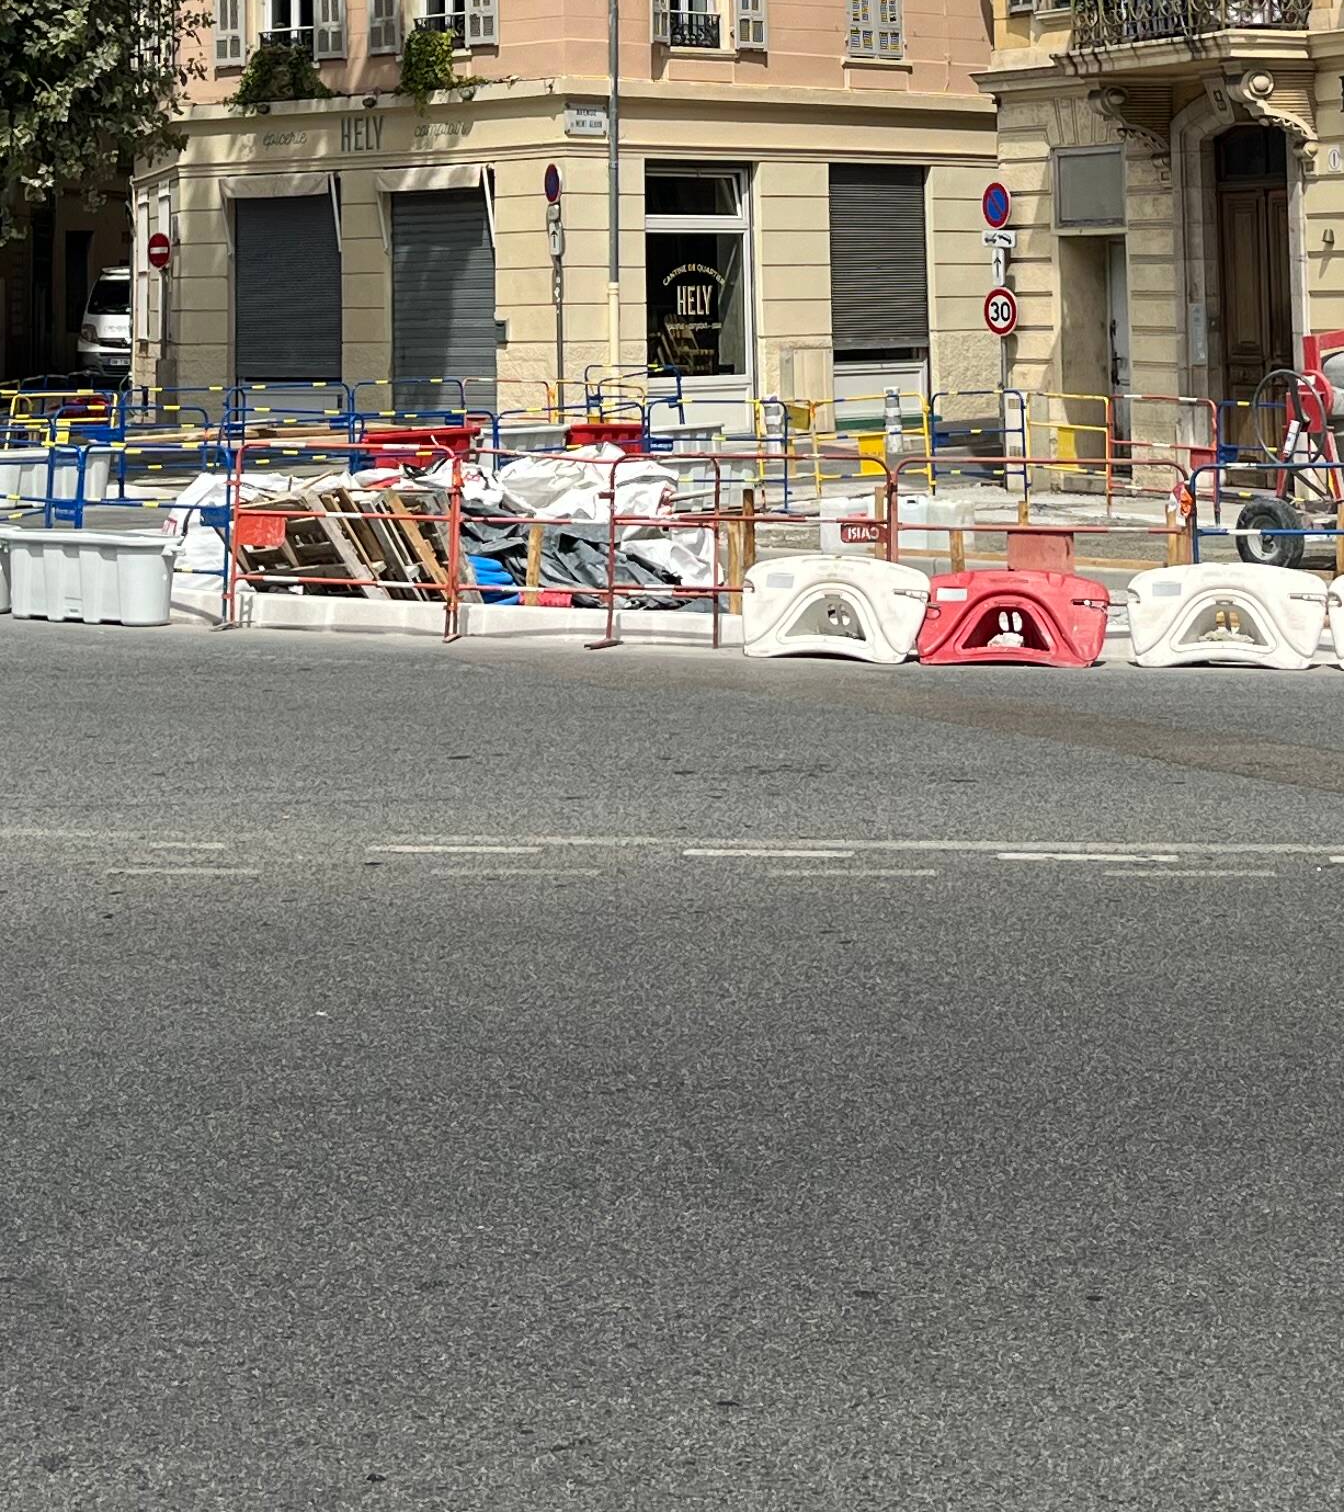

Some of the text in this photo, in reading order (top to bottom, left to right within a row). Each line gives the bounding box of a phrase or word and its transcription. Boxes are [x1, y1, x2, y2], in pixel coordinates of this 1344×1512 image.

[340, 115, 384, 153] HELY
[677, 285, 713, 315] HELY
[990, 301, 1011, 322] 30
